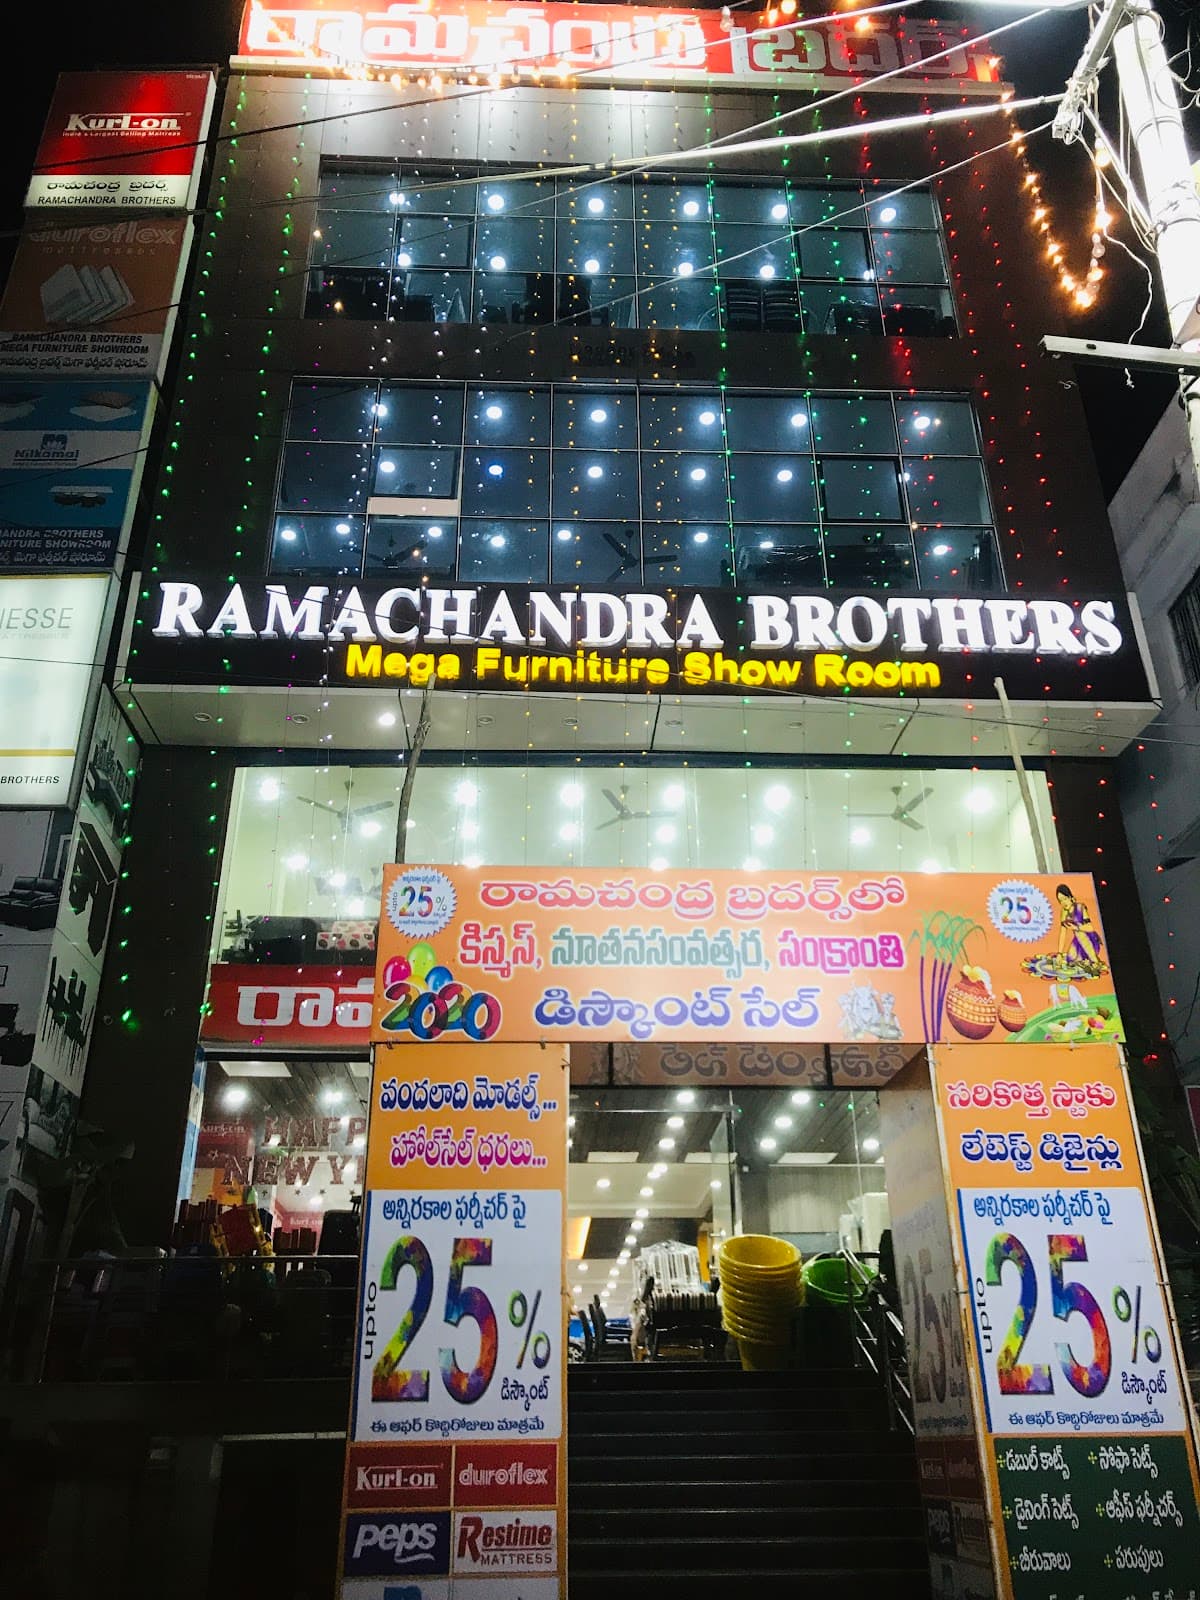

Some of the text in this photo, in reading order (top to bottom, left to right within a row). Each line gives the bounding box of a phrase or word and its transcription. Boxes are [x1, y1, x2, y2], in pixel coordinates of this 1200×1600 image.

[65, 112, 185, 131] Kurl-on
[37, 196, 176, 205] RAMACHANDRA BROTHERS
[29, 222, 178, 245] duroflex
[12, 333, 142, 344] RAMACHANDRA BROTHERS
[31, 343, 88, 353] FURNITURE
[90, 345, 149, 354] SHOWROOM
[14, 449, 79, 457] Nilkamal
[0, 529, 40, 538] ANDRA
[152, 582, 1122, 656] RAMACHANDRA BROTHERS
[346, 643, 941, 688] Mega Furniture Show Room
[1, 776, 59, 784] BROTHERS
[480, 879, 715, 920] రామచంద్ర
[777, 930, 905, 975] సంక్రాంతి
[381, 981, 502, 1041] 2020
[741, 985, 821, 1029] సేల్
[380, 1078, 468, 1110] వందలాది
[947, 1081, 1116, 1117] సరికొత్త స్టాకు
[962, 1129, 1122, 1171] లేటెస్ట్ డిజైన్లు
[382, 1195, 452, 1229] అన్నిరకాల
[512, 1194, 527, 1229] పై
[974, 1193, 1040, 1226] అన్నిరకాల
[1094, 1192, 1114, 1225] పై
[364, 1281, 377, 1360] upto
[976, 1277, 993, 1353] upto
[370, 1419, 386, 1432] ఈ
[389, 1417, 421, 1435] ఆఫర్
[497, 1416, 545, 1434] మాత్రమే
[1008, 1412, 1023, 1425] ఈ
[1025, 1410, 1055, 1428] ఆఫర్
[1121, 1409, 1164, 1427] మాత్రమే
[1006, 1445, 1038, 1471] డబుల్
[1099, 1446, 1130, 1474] సోఫా
[355, 1466, 443, 1490] Kurl-on
[458, 1462, 549, 1486] duroflex
[1014, 1493, 1051, 1530] డైనింగ్
[352, 1522, 438, 1563] peps
[457, 1516, 552, 1562] Restime
[480, 1553, 552, 1566] MATTRESS
[1019, 1545, 1071, 1571] బీరువాలు
[1115, 1544, 1164, 1573] పరుపులు
